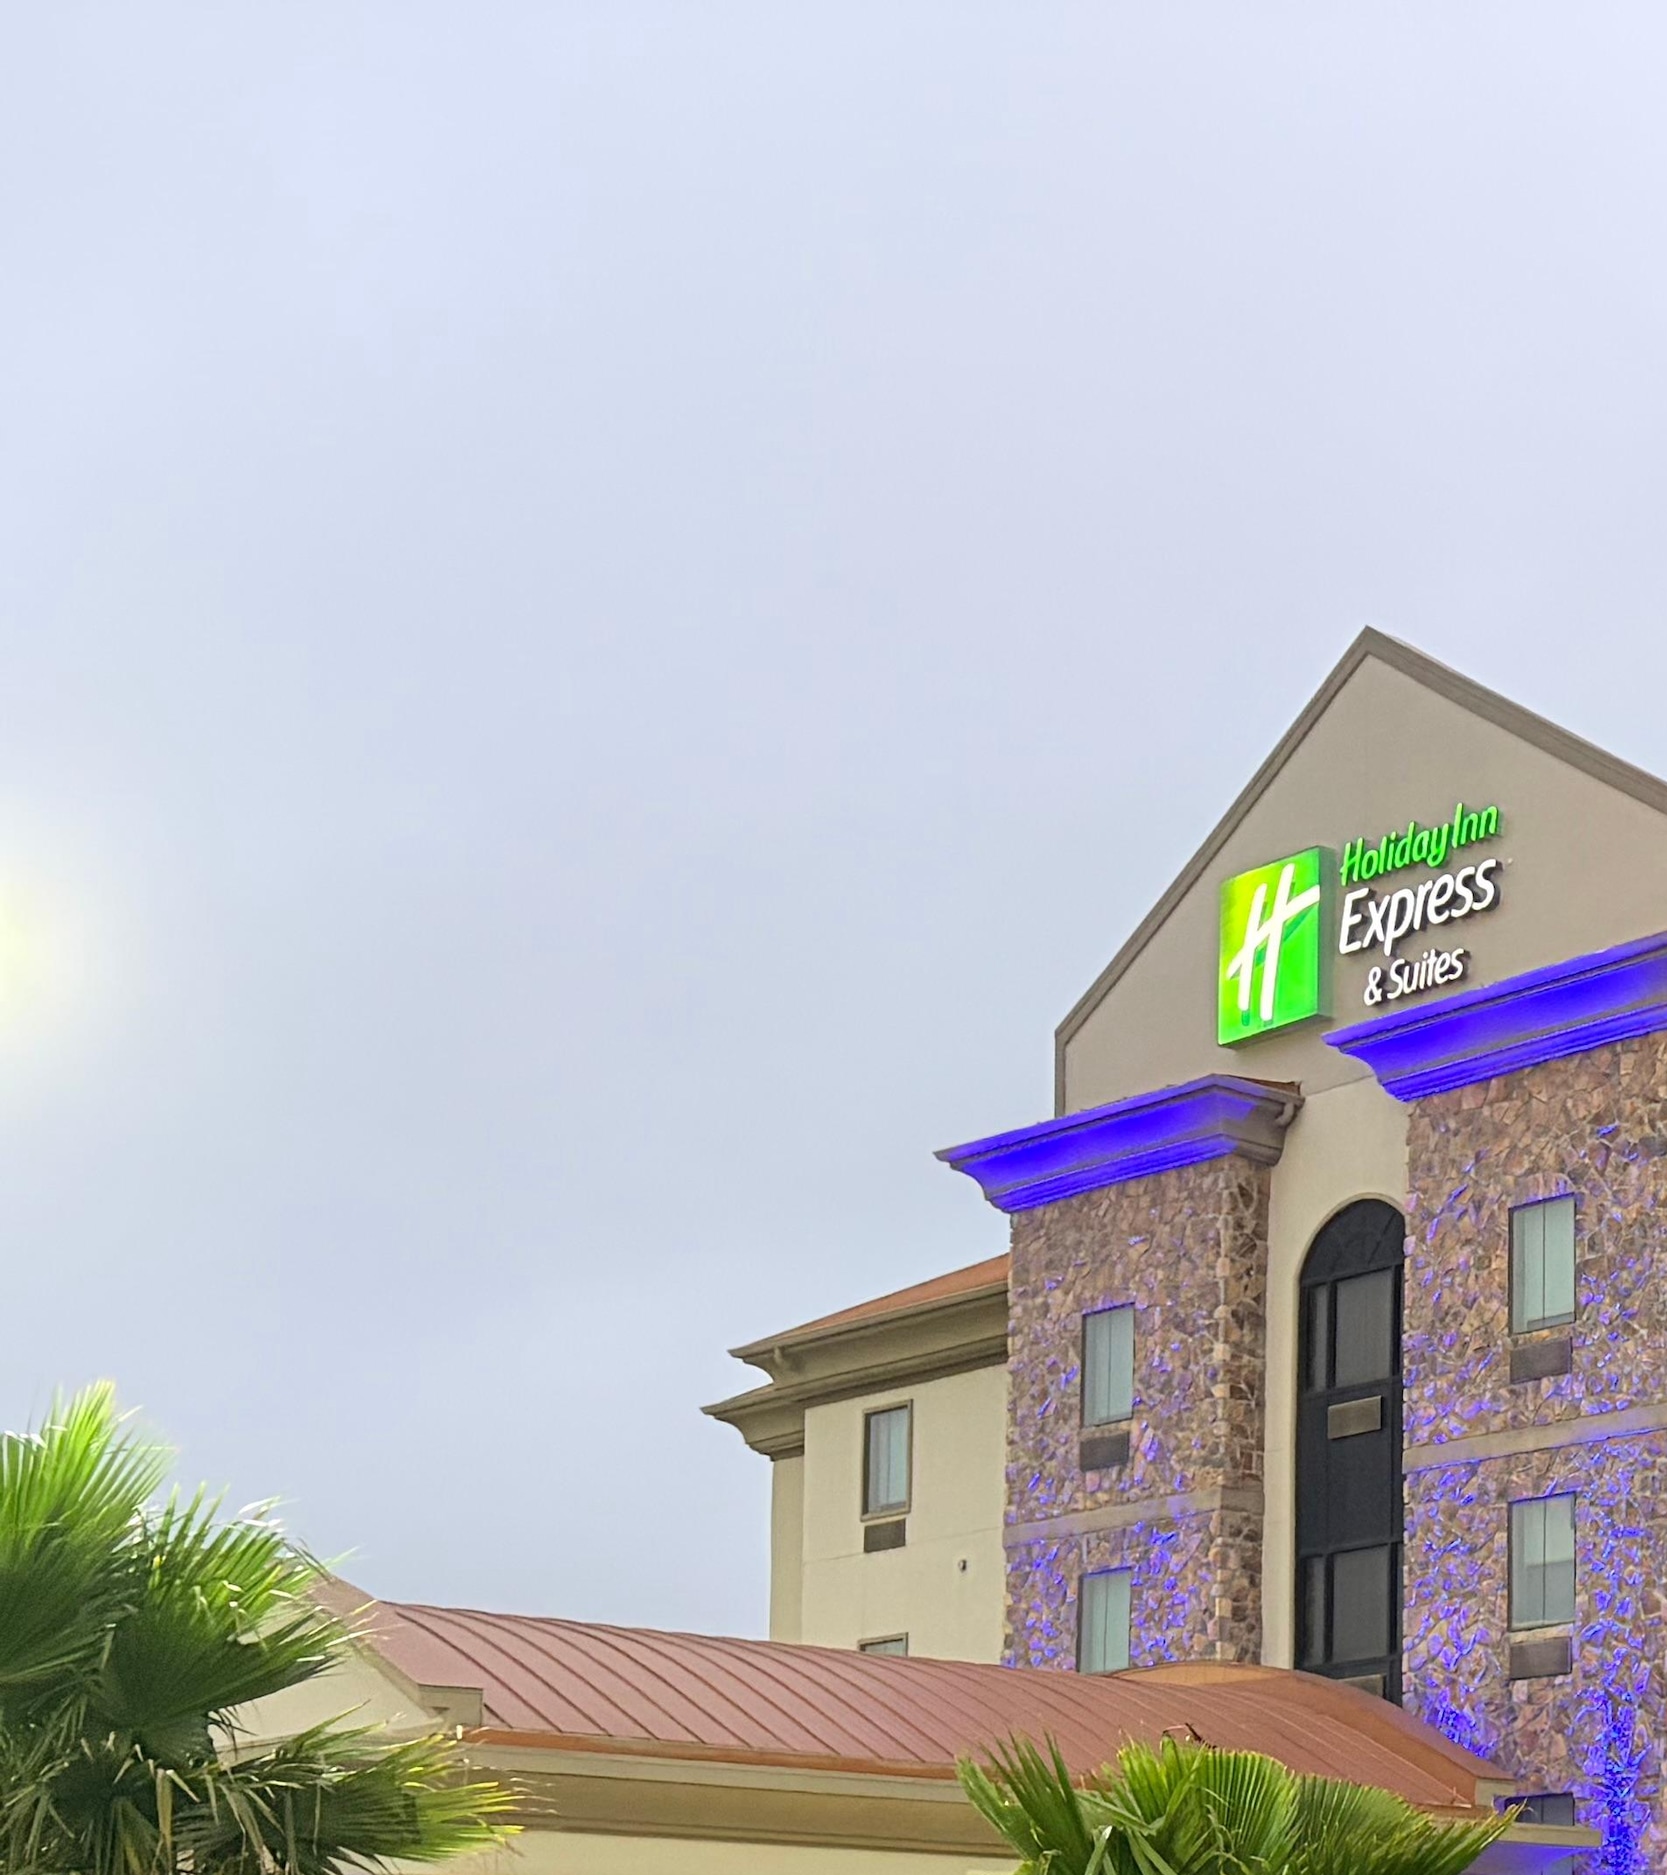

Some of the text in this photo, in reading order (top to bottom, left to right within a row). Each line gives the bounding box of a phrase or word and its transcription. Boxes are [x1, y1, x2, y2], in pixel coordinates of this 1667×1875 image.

[1340, 803, 1498, 886] Holiday Inn
[1339, 859, 1497, 956] Express
[1364, 948, 1465, 1006] & Suites
